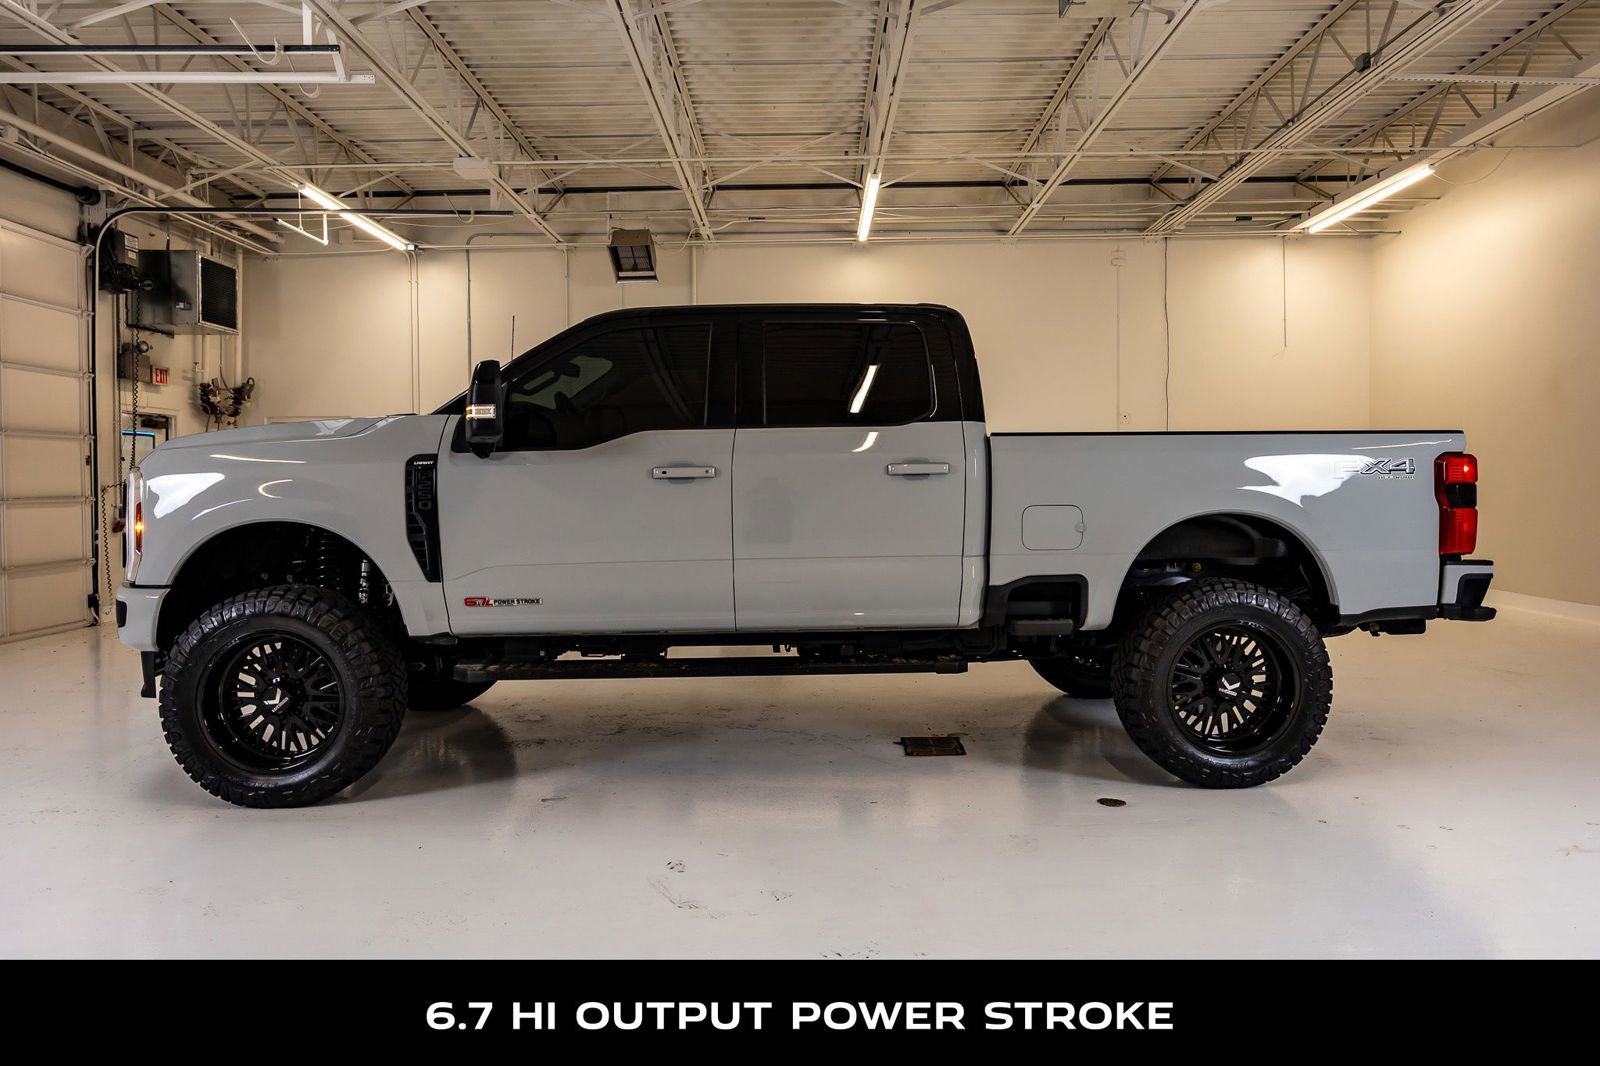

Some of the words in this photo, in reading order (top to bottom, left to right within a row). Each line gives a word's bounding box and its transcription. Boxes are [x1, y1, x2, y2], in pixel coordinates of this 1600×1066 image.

[155, 367, 170, 385] EXIT
[1329, 459, 1416, 480] FX4
[494, 598, 516, 606] POWER
